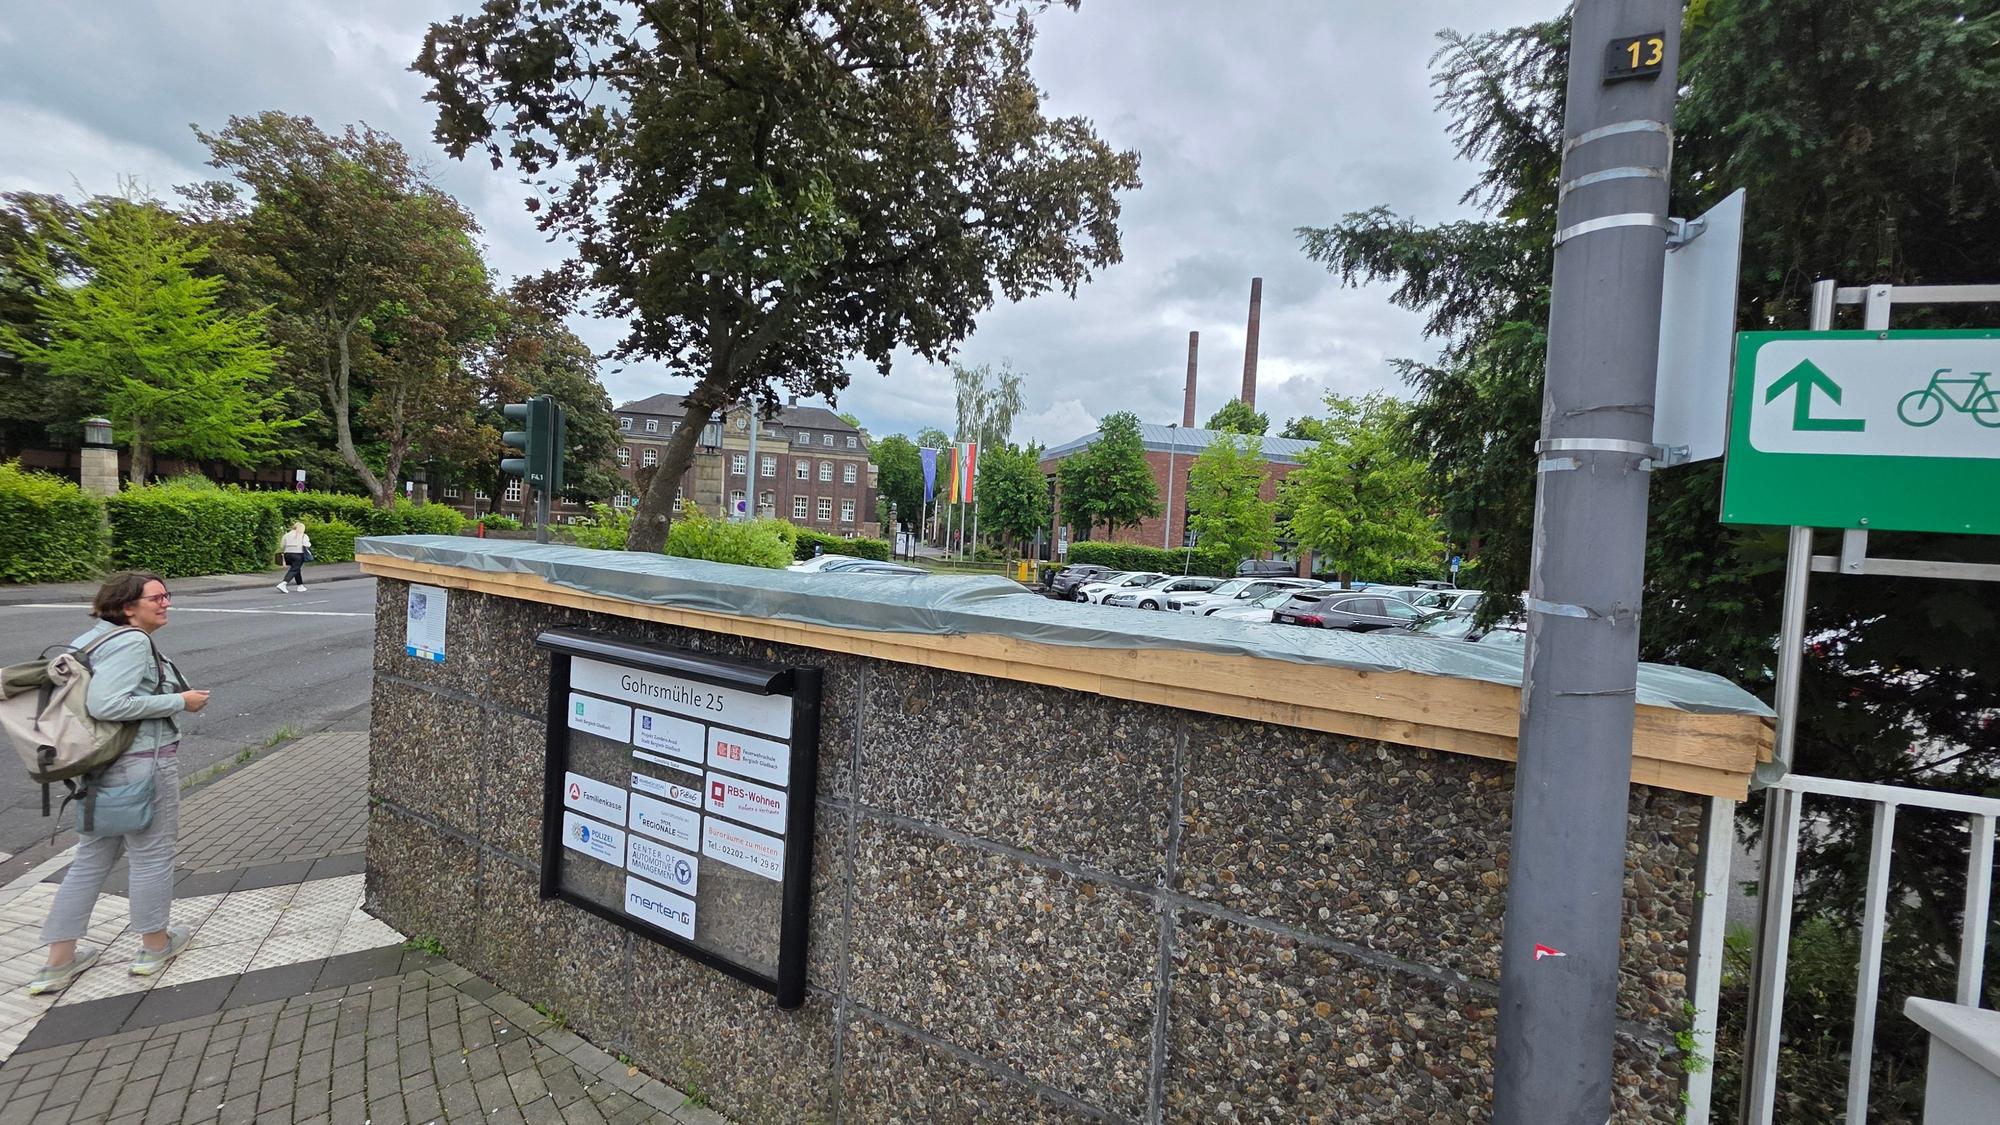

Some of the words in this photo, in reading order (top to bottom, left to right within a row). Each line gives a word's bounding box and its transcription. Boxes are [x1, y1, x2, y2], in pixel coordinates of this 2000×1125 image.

[1627, 38, 1664, 69] 13
[621, 674, 702, 707] Gohrsmühle
[706, 693, 724, 712] 25
[743, 748, 776, 762] Feuerwehrschule
[583, 791, 622, 811] Familienkasse
[727, 785, 780, 809] RBS-Wohnen
[591, 829, 614, 843] POLIZEI
[642, 818, 677, 837] REGIONALE
[632, 842, 662, 858] CENTER
[665, 854, 676, 864] OF
[708, 826, 744, 845] Büroräume
[754, 844, 778, 857] mieten
[631, 851, 672, 872] AUTOMOTIVE
[631, 858, 675, 881] MANAGEMENT
[722, 845, 744, 859] 02202
[760, 858, 769, 869] 29
[770, 862, 780, 872] 87
[630, 893, 681, 922] menten
